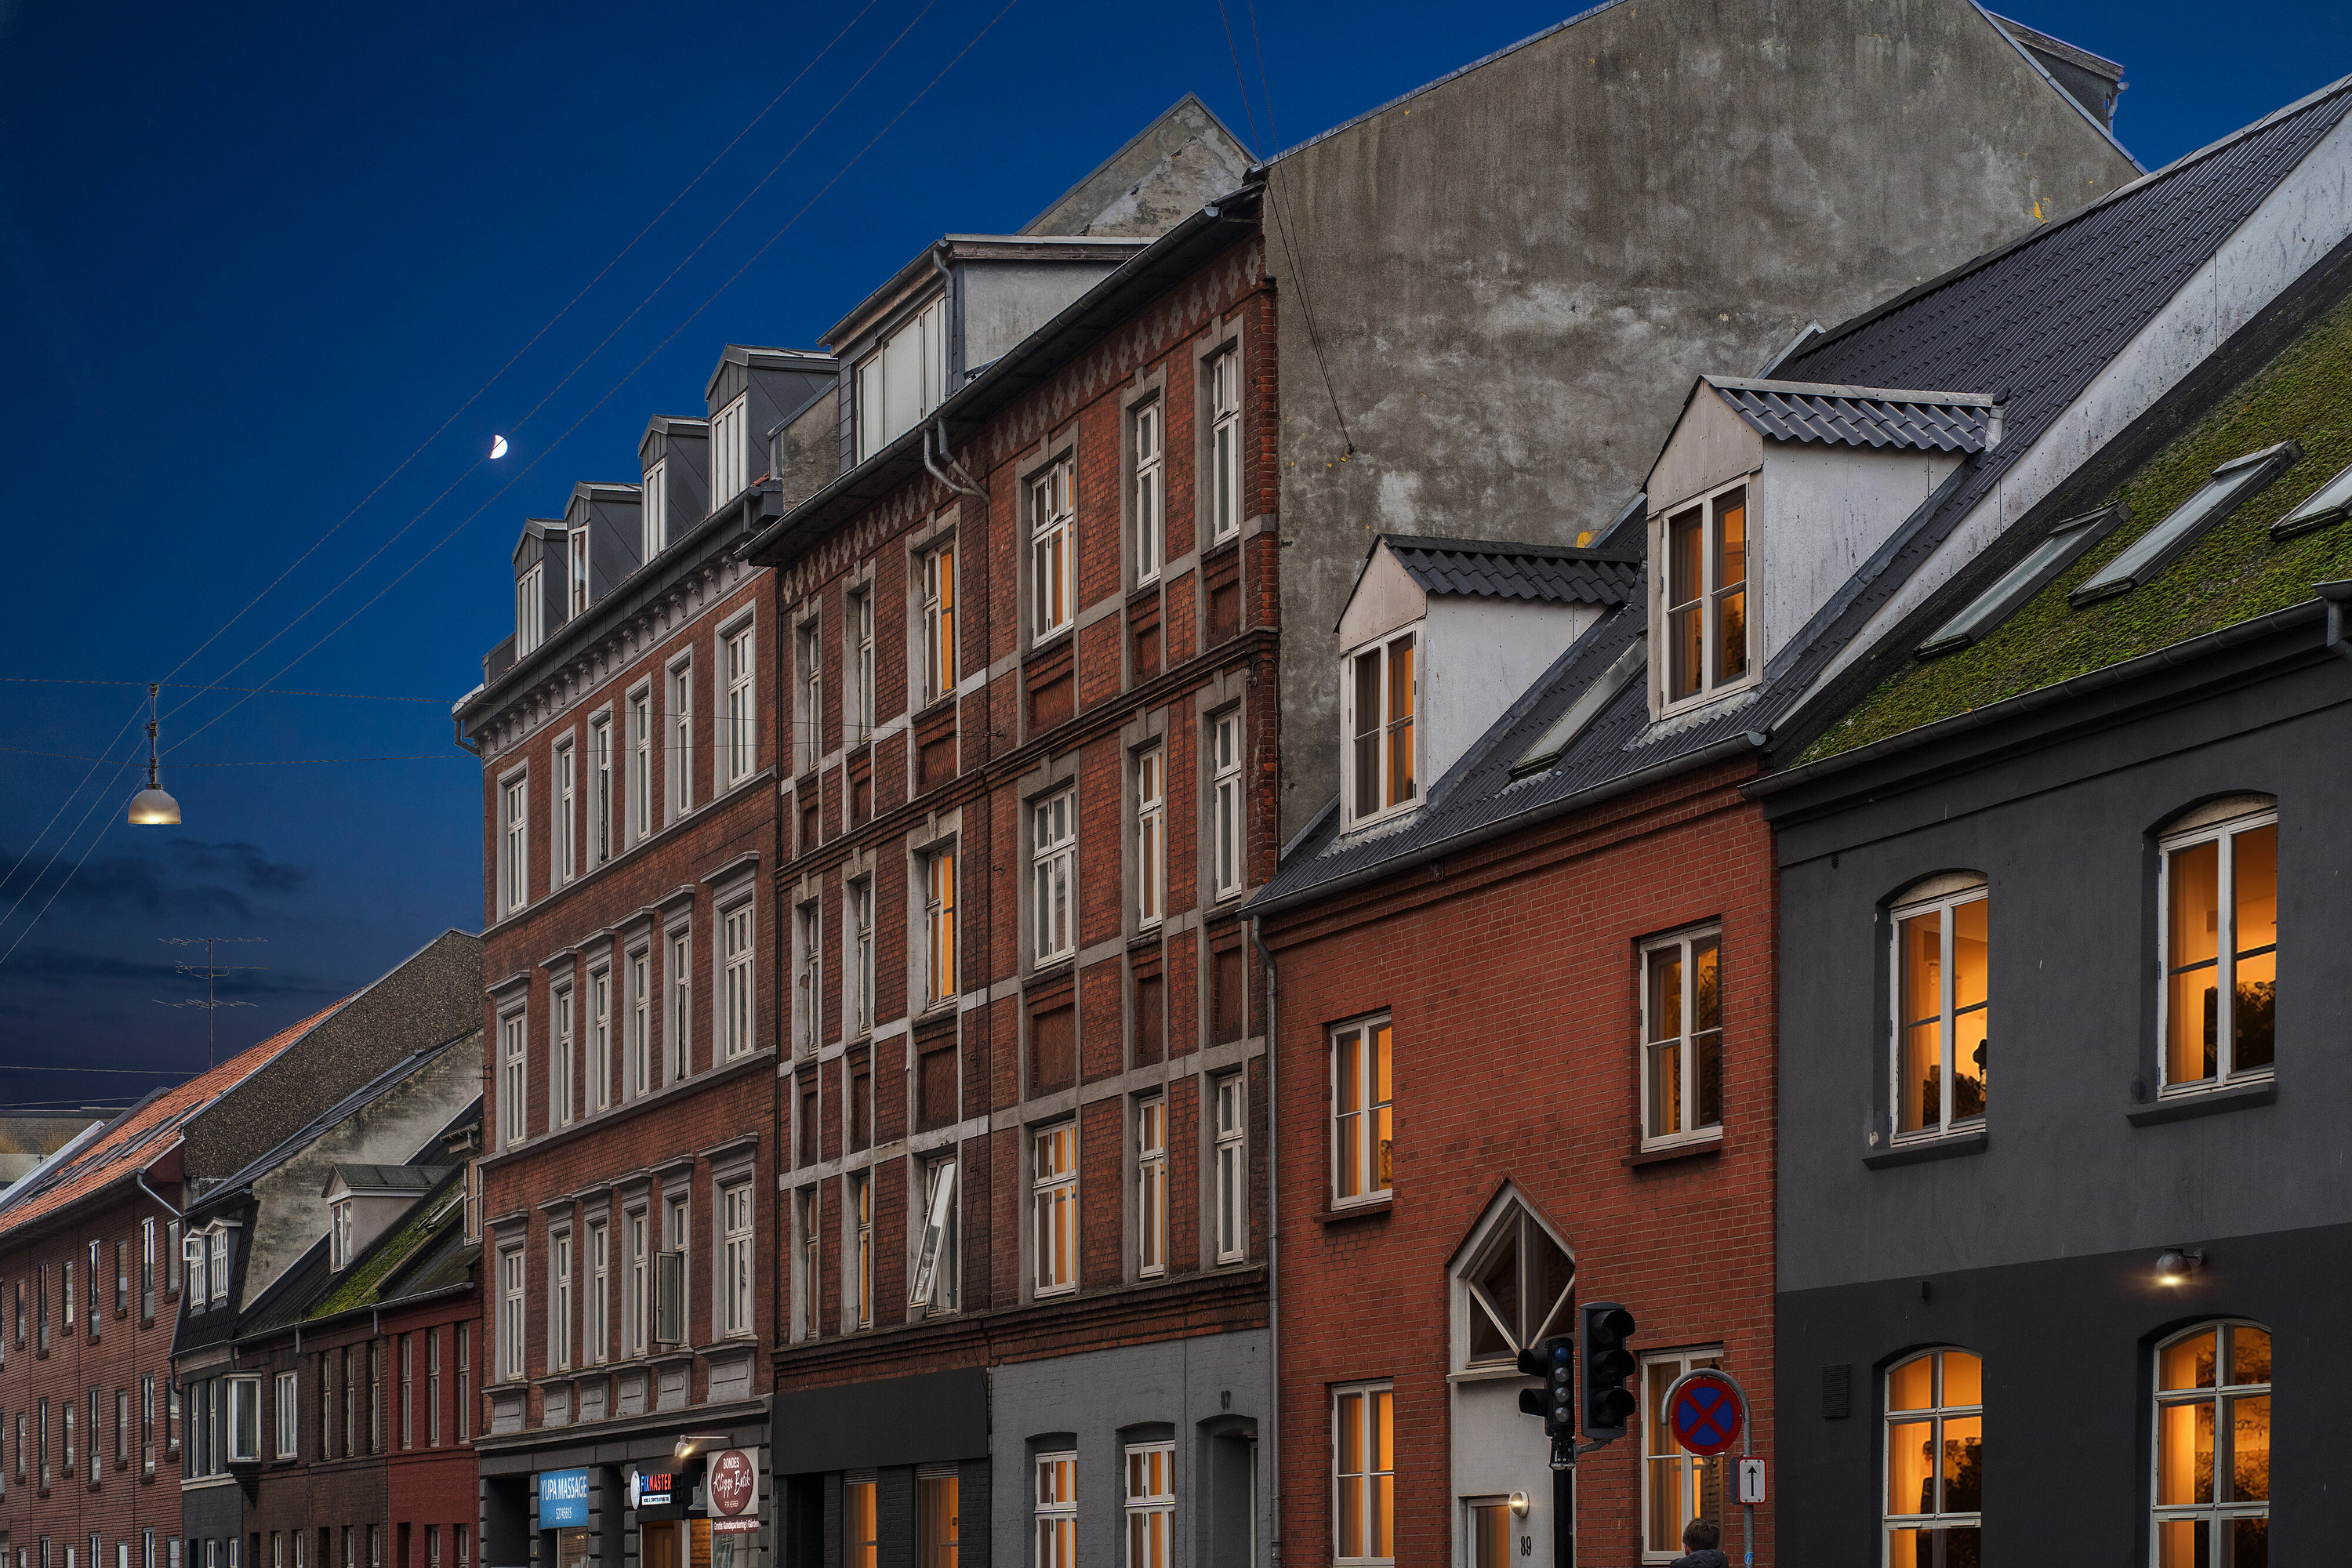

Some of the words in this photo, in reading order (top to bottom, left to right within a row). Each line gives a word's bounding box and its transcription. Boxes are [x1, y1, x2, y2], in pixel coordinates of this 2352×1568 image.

[723, 1457, 740, 1469] BONDES
[541, 1479, 557, 1501] YUPA
[558, 1475, 587, 1499] MASSAGE
[641, 1473, 672, 1492] FIXMASTER
[1521, 1535, 1532, 1556] 89
